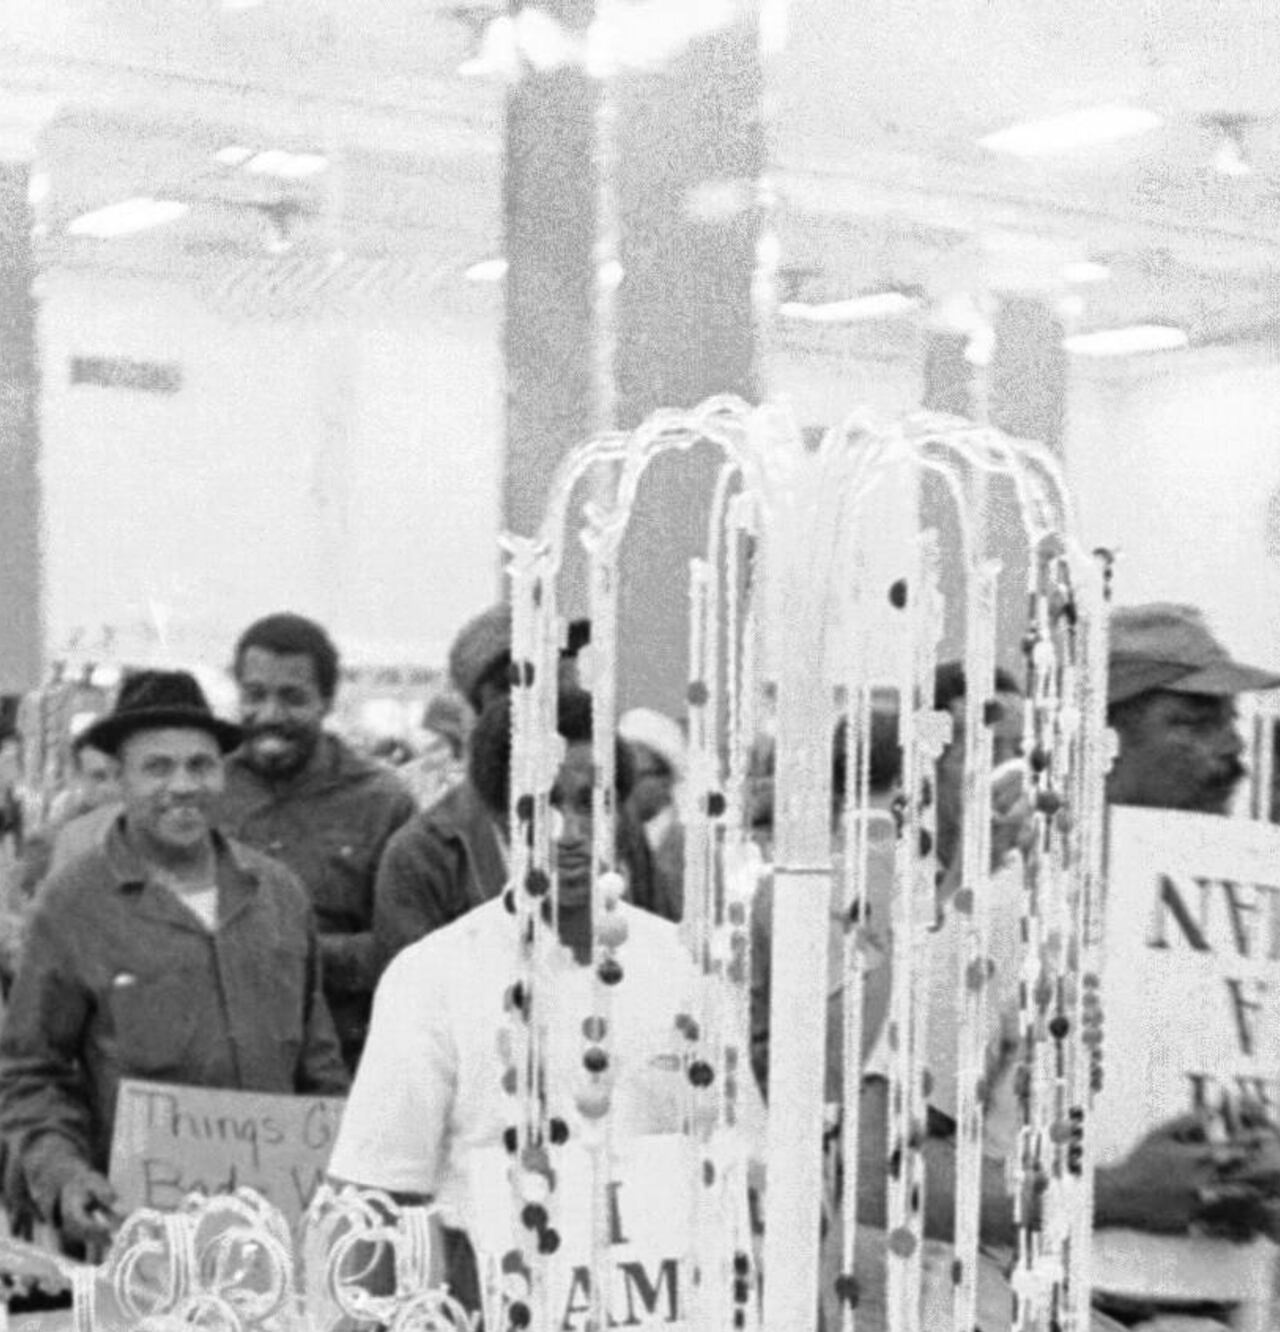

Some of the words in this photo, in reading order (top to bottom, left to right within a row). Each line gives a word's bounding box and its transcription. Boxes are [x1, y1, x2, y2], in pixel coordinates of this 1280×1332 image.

[127, 1086, 285, 1171] Things
[605, 1180, 629, 1244] I
[562, 1258, 680, 1332] AM
